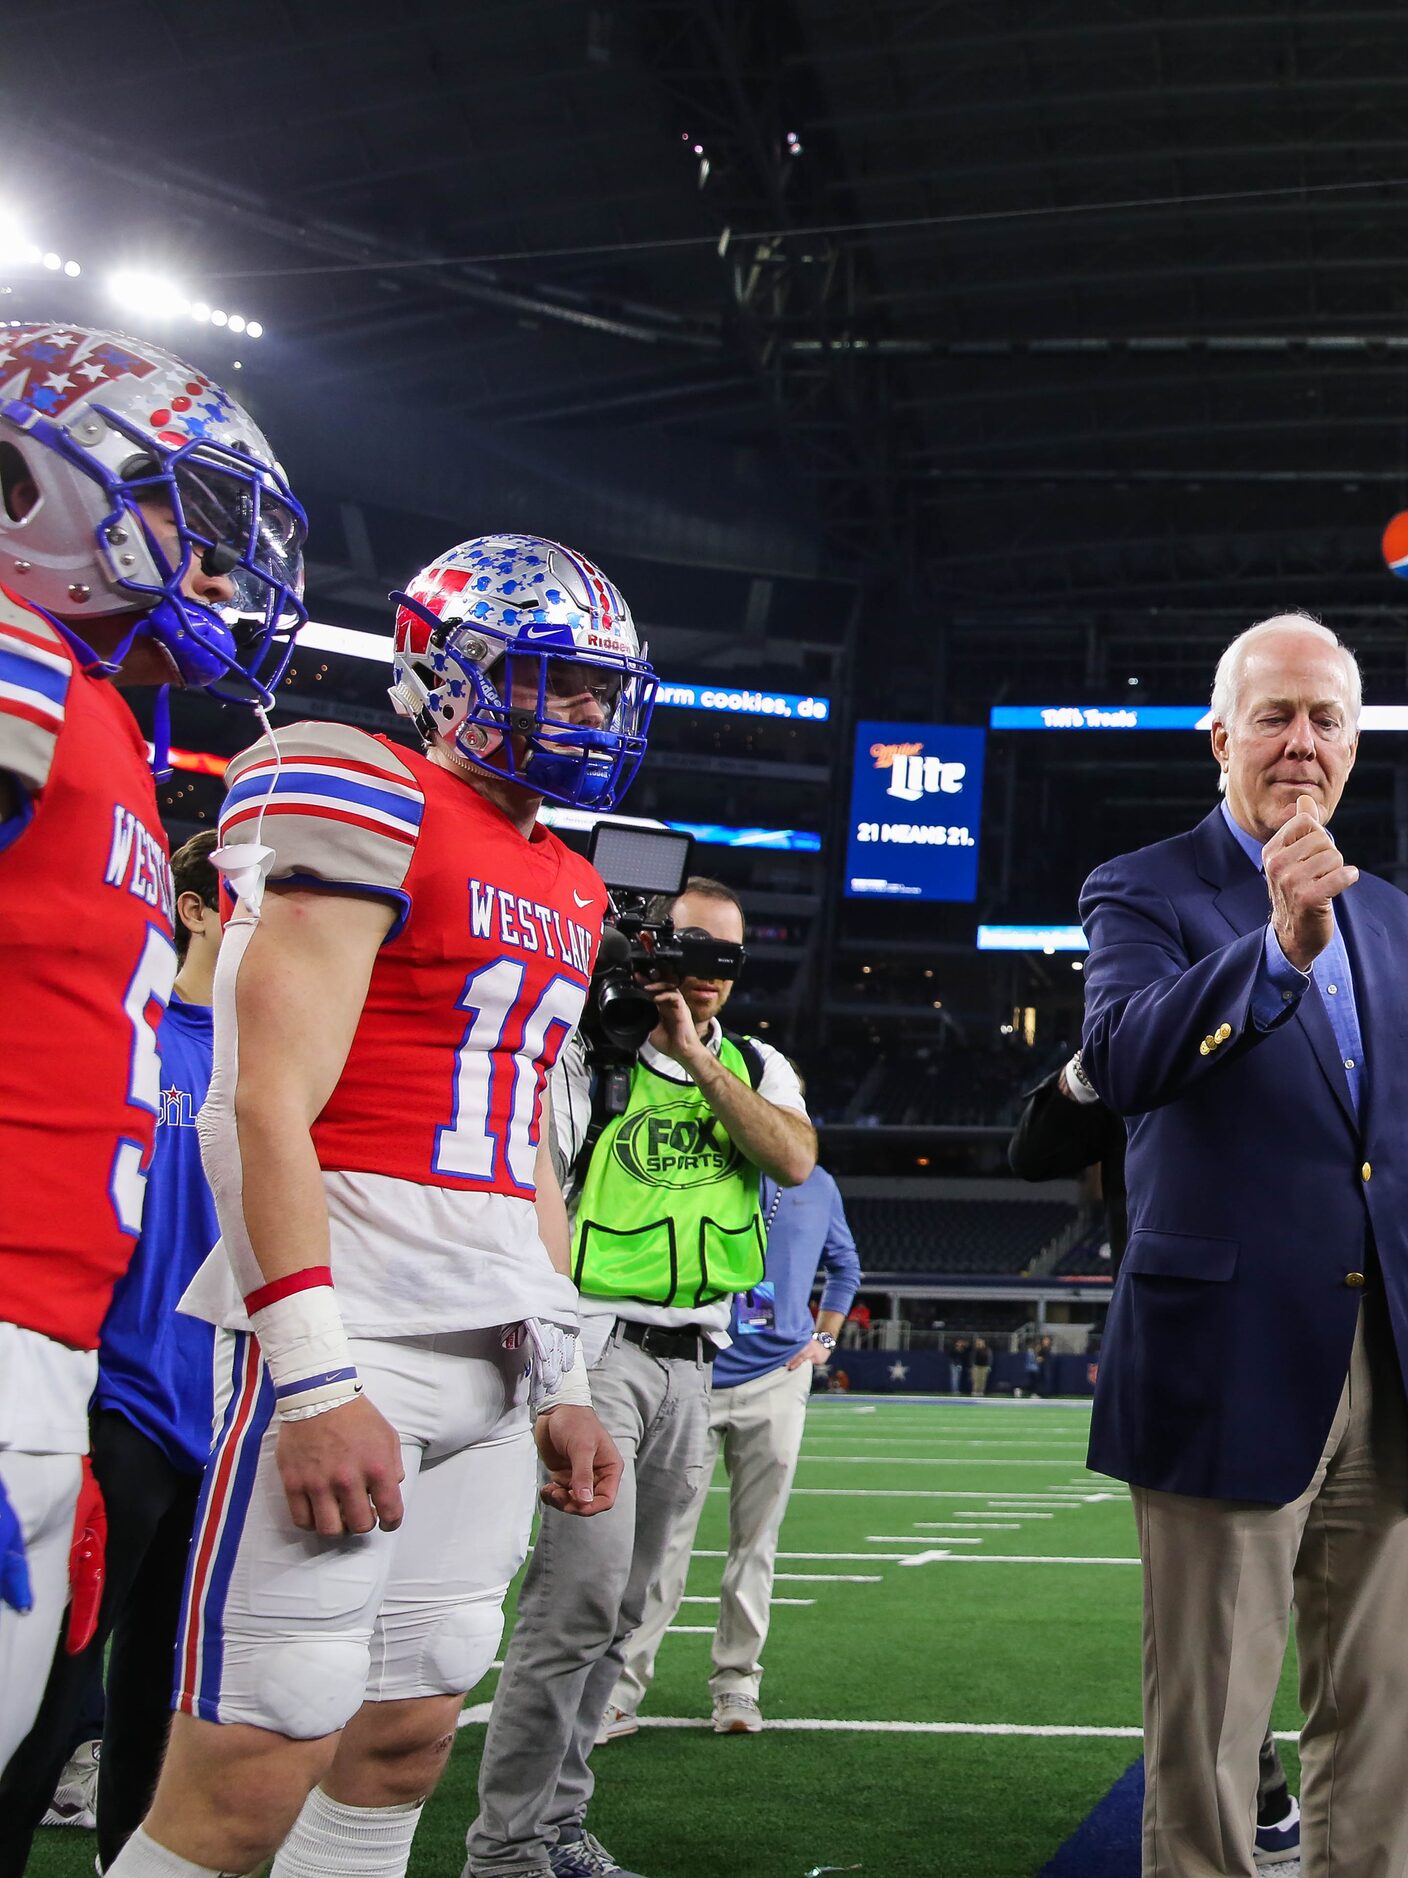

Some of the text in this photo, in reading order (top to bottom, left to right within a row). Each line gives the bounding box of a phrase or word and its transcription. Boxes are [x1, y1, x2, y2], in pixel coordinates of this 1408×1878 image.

[700, 690, 792, 717] cookies,
[797, 697, 827, 719] de
[886, 754, 966, 801] Lite
[857, 822, 880, 842] 21
[431, 954, 588, 1190] 10
[648, 1116, 723, 1155] FOX
